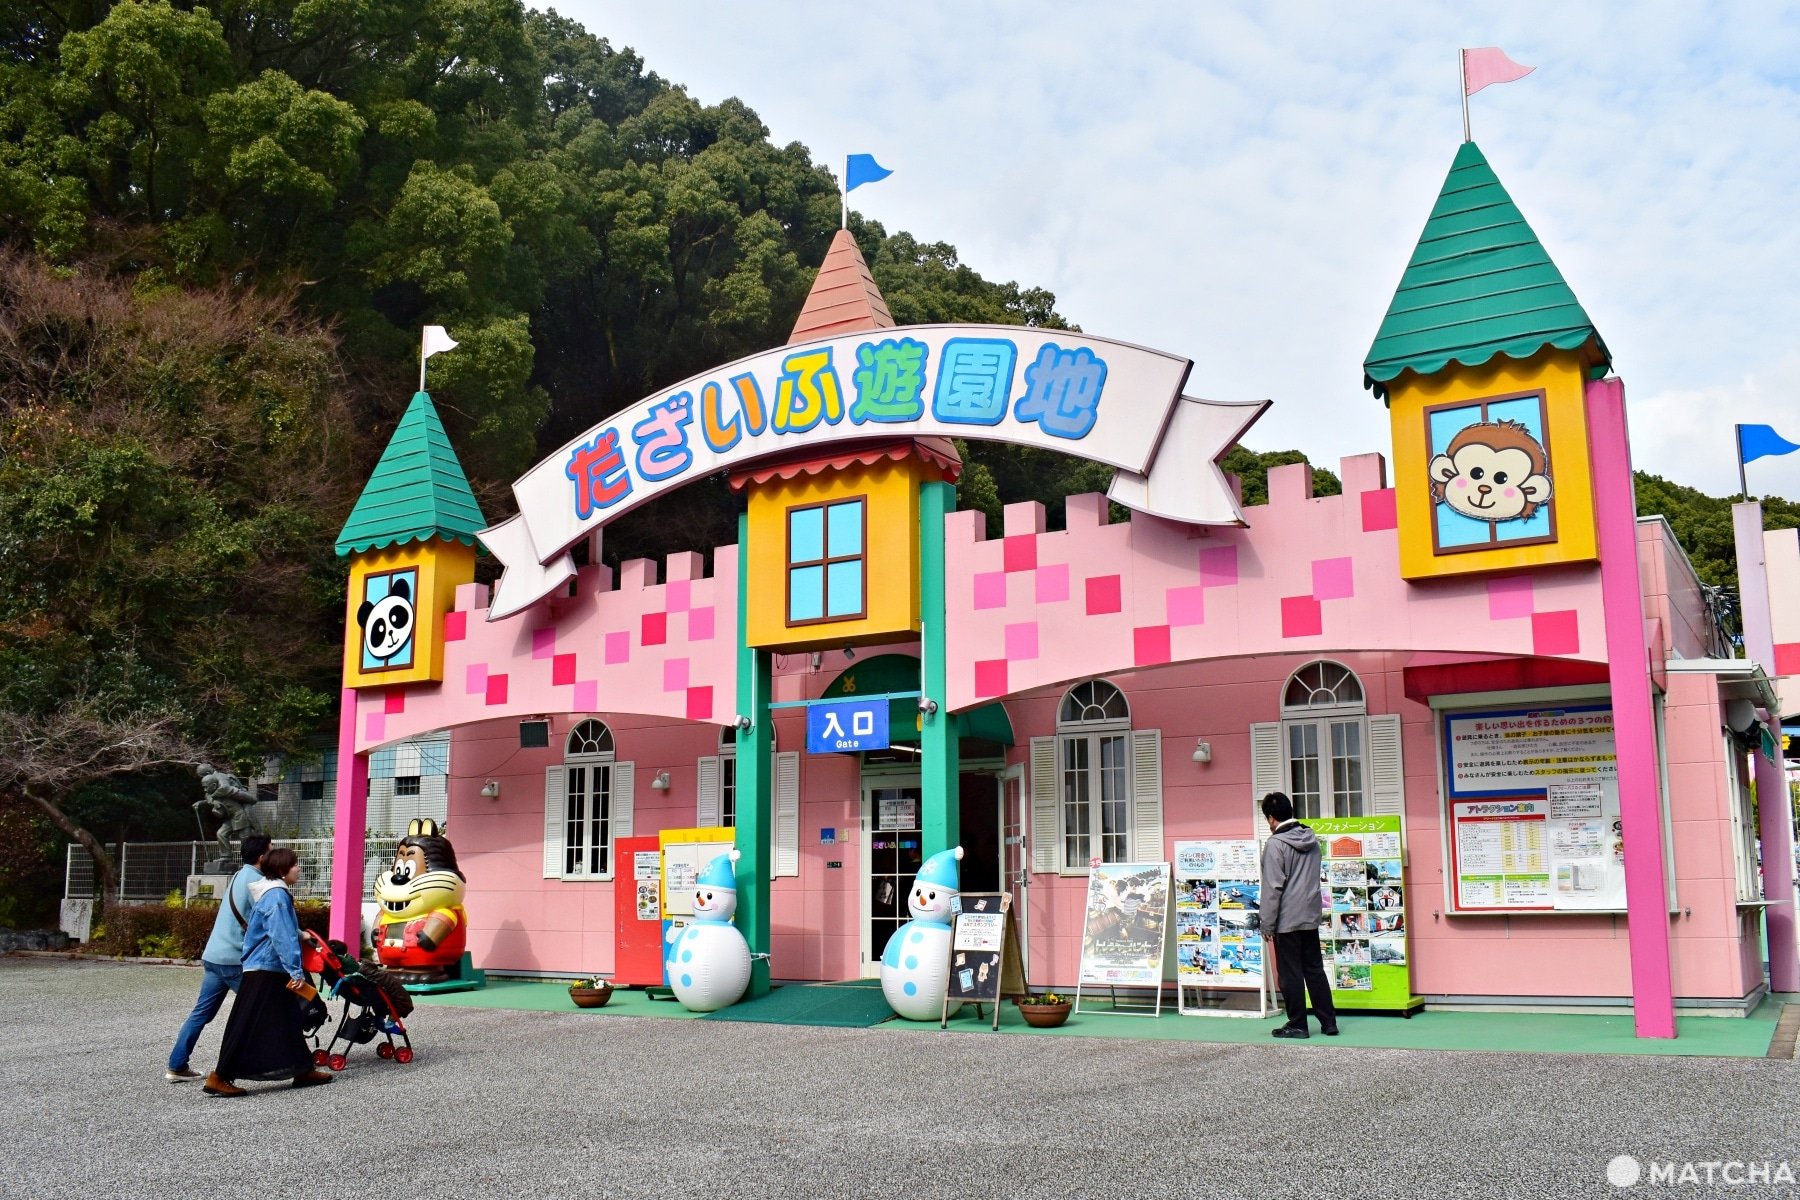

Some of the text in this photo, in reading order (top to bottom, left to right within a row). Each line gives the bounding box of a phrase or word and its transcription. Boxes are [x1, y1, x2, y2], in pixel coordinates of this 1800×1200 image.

[566, 337, 1108, 520] だざいふ遊園地
[822, 711, 874, 738] 入口
[1475, 715, 1614, 731] 楽しい思い出を作るための3つの約
[836, 740, 859, 748] Gate
